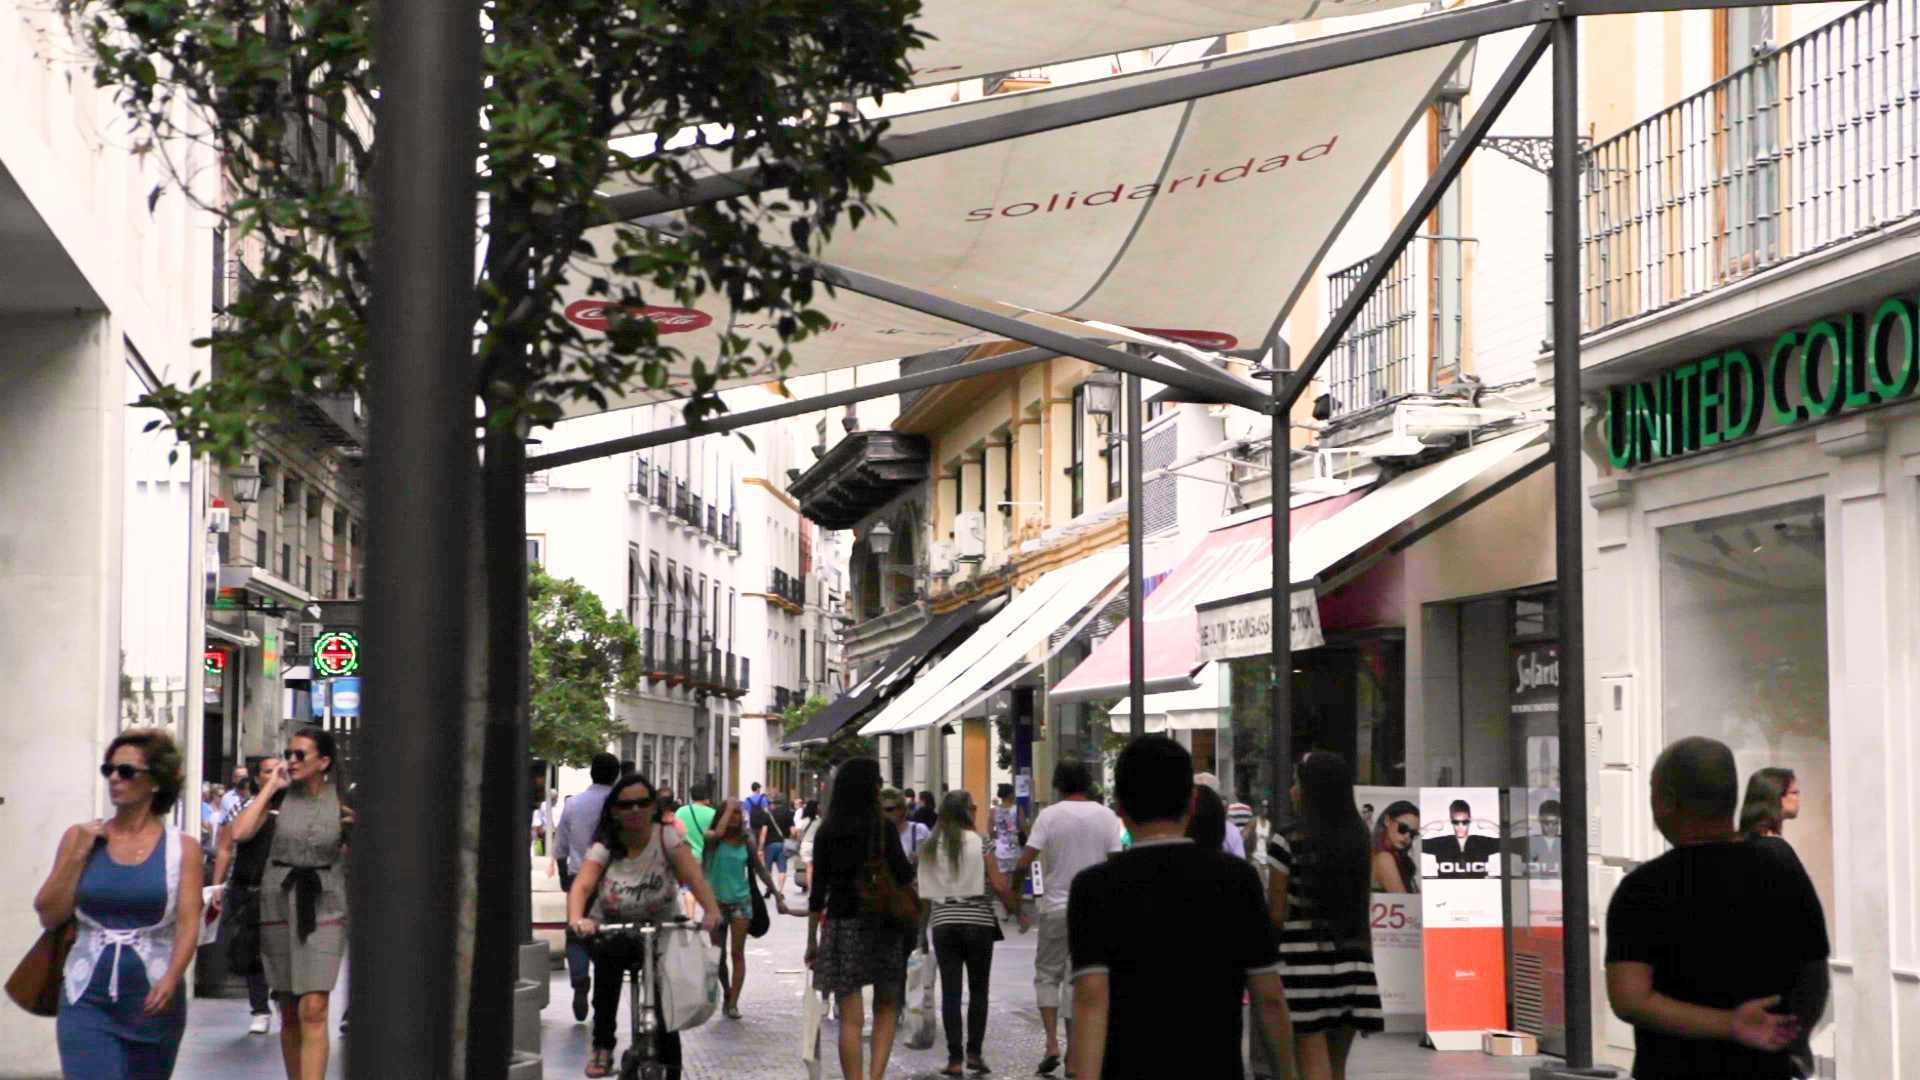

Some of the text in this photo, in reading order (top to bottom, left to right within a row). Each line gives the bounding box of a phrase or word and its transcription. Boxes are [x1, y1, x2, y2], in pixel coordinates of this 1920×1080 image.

[965, 135, 1338, 222] solidaridad
[1605, 297, 1920, 468] UNITED COLO
